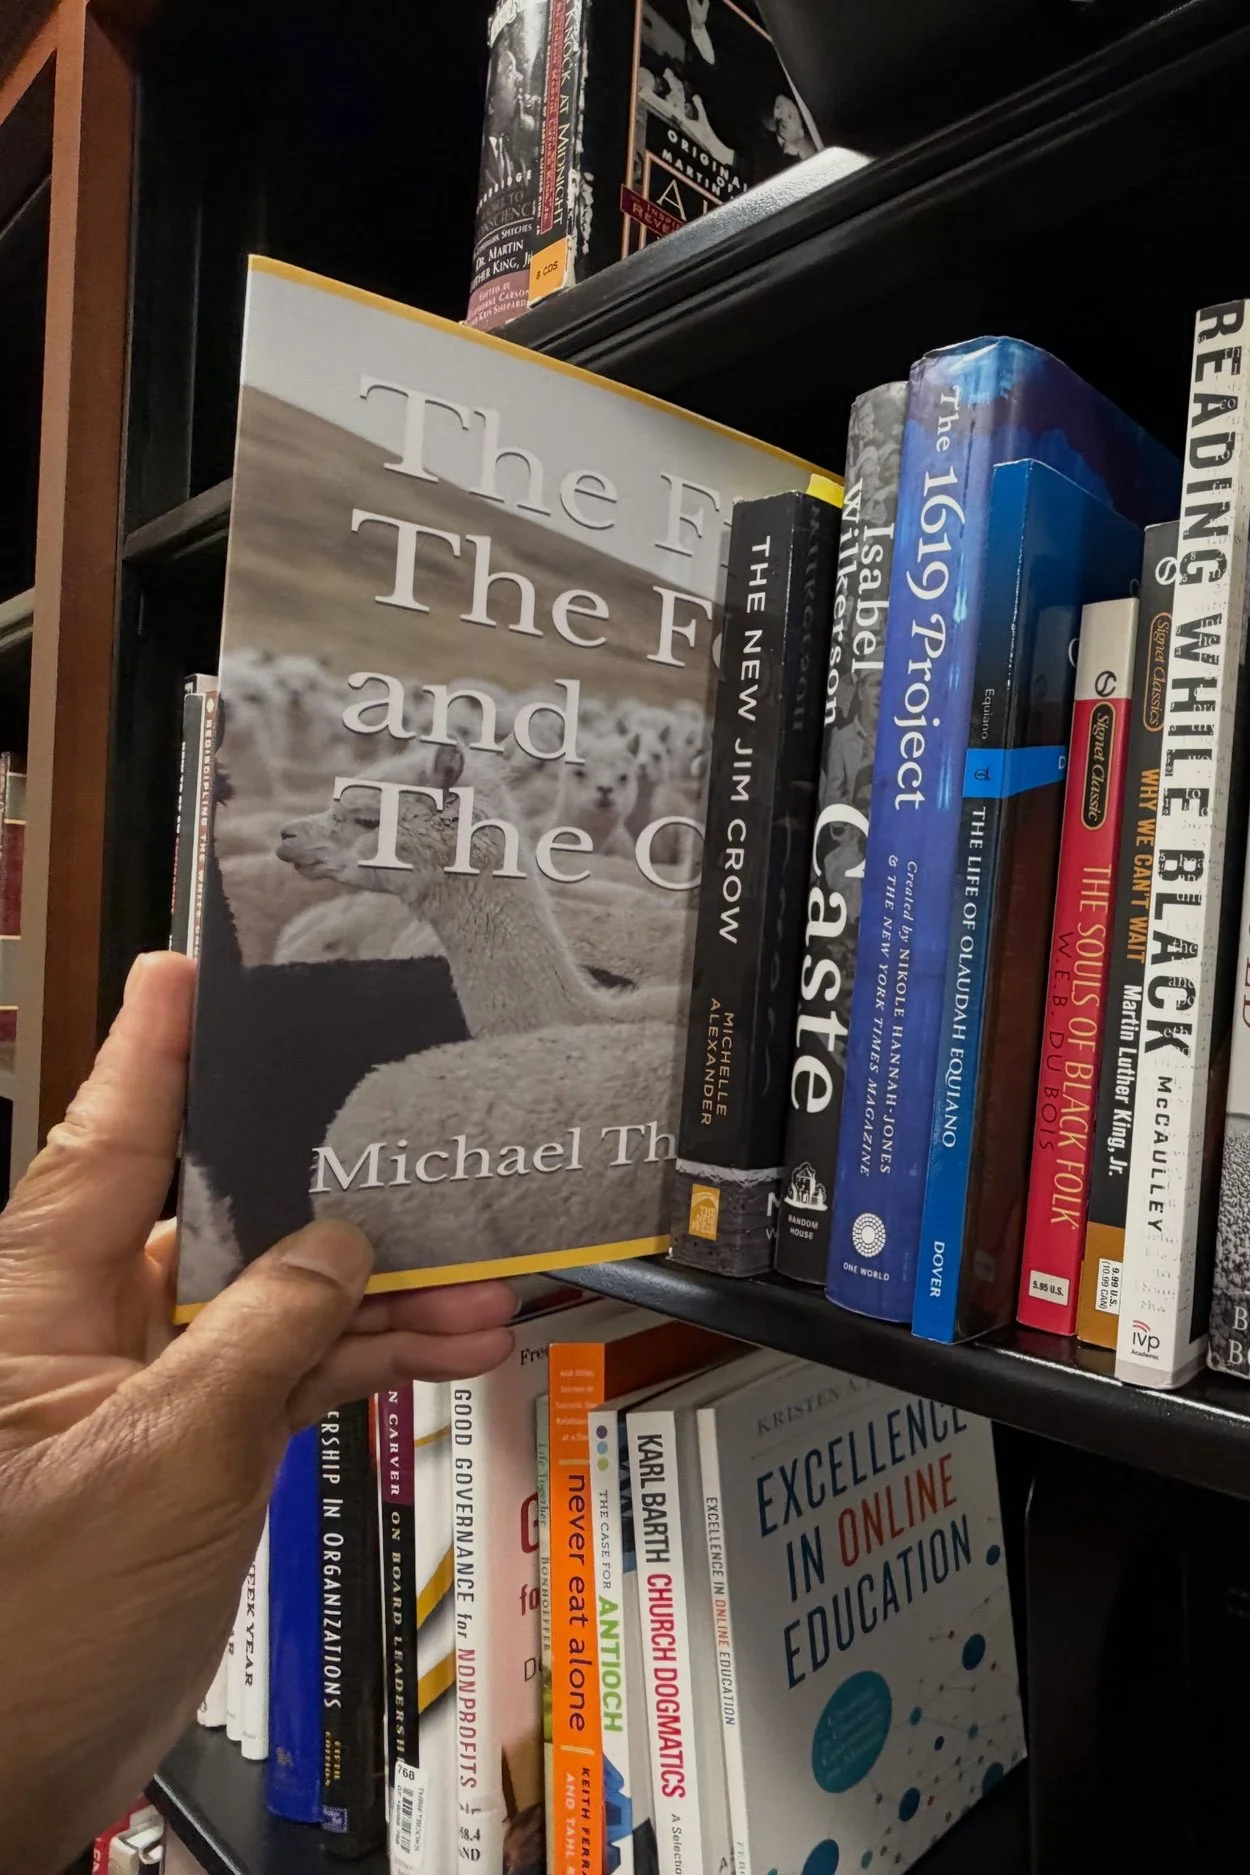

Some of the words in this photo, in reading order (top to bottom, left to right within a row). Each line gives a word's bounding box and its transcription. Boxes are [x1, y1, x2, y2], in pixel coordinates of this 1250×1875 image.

[561, 6, 577, 87] KNOCK
[559, 94, 570, 115] AT
[553, 123, 570, 225] MIDNIGHT
[662, 149, 721, 196] MARTIN
[488, 240, 524, 262] MARTIN
[359, 375, 618, 530] The
[936, 384, 962, 452] The
[1179, 299, 1245, 585] READING
[906, 465, 966, 600] 1619
[350, 508, 610, 647] The
[746, 535, 771, 613] THE
[824, 477, 863, 725] Wilkerson
[851, 522, 895, 673] Isabel
[737, 629, 763, 722] NEW
[341, 669, 587, 765] and
[894, 612, 947, 811] Project
[981, 688, 996, 740] Equiano
[1162, 612, 1223, 817] WHILE
[730, 738, 753, 801] JIM
[1138, 768, 1160, 813] WHY
[333, 776, 594, 884] The
[970, 806, 987, 849] THE
[1136, 824, 1157, 847] WE
[718, 818, 747, 945] CROW
[884, 874, 897, 911] THE
[902, 861, 918, 921] Created
[965, 856, 982, 897] LIFE
[1079, 864, 1111, 913] THE
[880, 915, 893, 958] NEW
[898, 923, 913, 944] by
[962, 902, 977, 930] OF
[1126, 917, 1149, 963] WAIT
[790, 803, 870, 1114] Caste
[875, 963, 889, 1012] YORK
[893, 948, 910, 1017] NIKOLE
[950, 937, 975, 1040] OLAUDAH
[1070, 923, 1107, 1007] SOULS
[1144, 849, 1205, 1059] BLACK
[868, 1017, 883, 1075] TIMES
[1067, 1017, 1098, 1052] OF
[1119, 984, 1143, 1041] Martin
[700, 997, 721, 1126] ALEXANDER
[715, 1012, 735, 1117] MICHELLE
[1114, 1048, 1138, 1103] Luther
[860, 1080, 878, 1177] MAGAZINE
[880, 1024, 904, 1175] HANNAH-JONES
[942, 1047, 965, 1149] EQUIANO
[1057, 1060, 1094, 1151] BLACK
[1106, 1108, 1133, 1153] King,
[308, 1126, 583, 1195] Michael
[1108, 1157, 1128, 1176] Jr.
[1147, 1076, 1173, 1232] McCAULLEY
[787, 1213, 819, 1230] RANDOM
[1051, 1158, 1085, 1230] FOLK
[789, 1226, 814, 1240] HOUSE
[843, 1262, 858, 1275] ONE
[860, 1267, 890, 1282] WORLD
[929, 1240, 946, 1298] DOVER
[454, 1388, 473, 1446] GOOD
[388, 1413, 400, 1496] CARVER
[637, 1434, 666, 1489] KARL
[756, 1399, 967, 1539] EXCELLENCE
[323, 1498, 343, 1518] IN
[391, 1511, 400, 1540] ON
[454, 1457, 475, 1604] GOVERNANCE
[568, 1473, 586, 1567] never
[598, 1490, 609, 1519] THE
[641, 1493, 671, 1564] BARTH
[706, 1497, 725, 1579] EXCELLENCE
[787, 1525, 825, 1603] IN
[837, 1452, 958, 1568] ONLINE
[600, 1525, 610, 1566] CASE
[602, 1569, 611, 1590] FOR
[323, 1532, 344, 1708] ORGANIZATIONS
[392, 1552, 402, 1625] BOARD
[568, 1576, 586, 1628] eat
[647, 1573, 678, 1662] CHURCH
[713, 1582, 726, 1596] IN
[714, 1599, 730, 1647] ONLINE
[784, 1513, 972, 1690] EDUCATION
[456, 1613, 473, 1638] for
[568, 1638, 593, 1732] alone
[598, 1595, 624, 1734] ANTIOCH
[719, 1651, 735, 1726] EDUCATION
[457, 1647, 477, 1789] NONPROFITS
[653, 1666, 686, 1800] DOGMATICS
